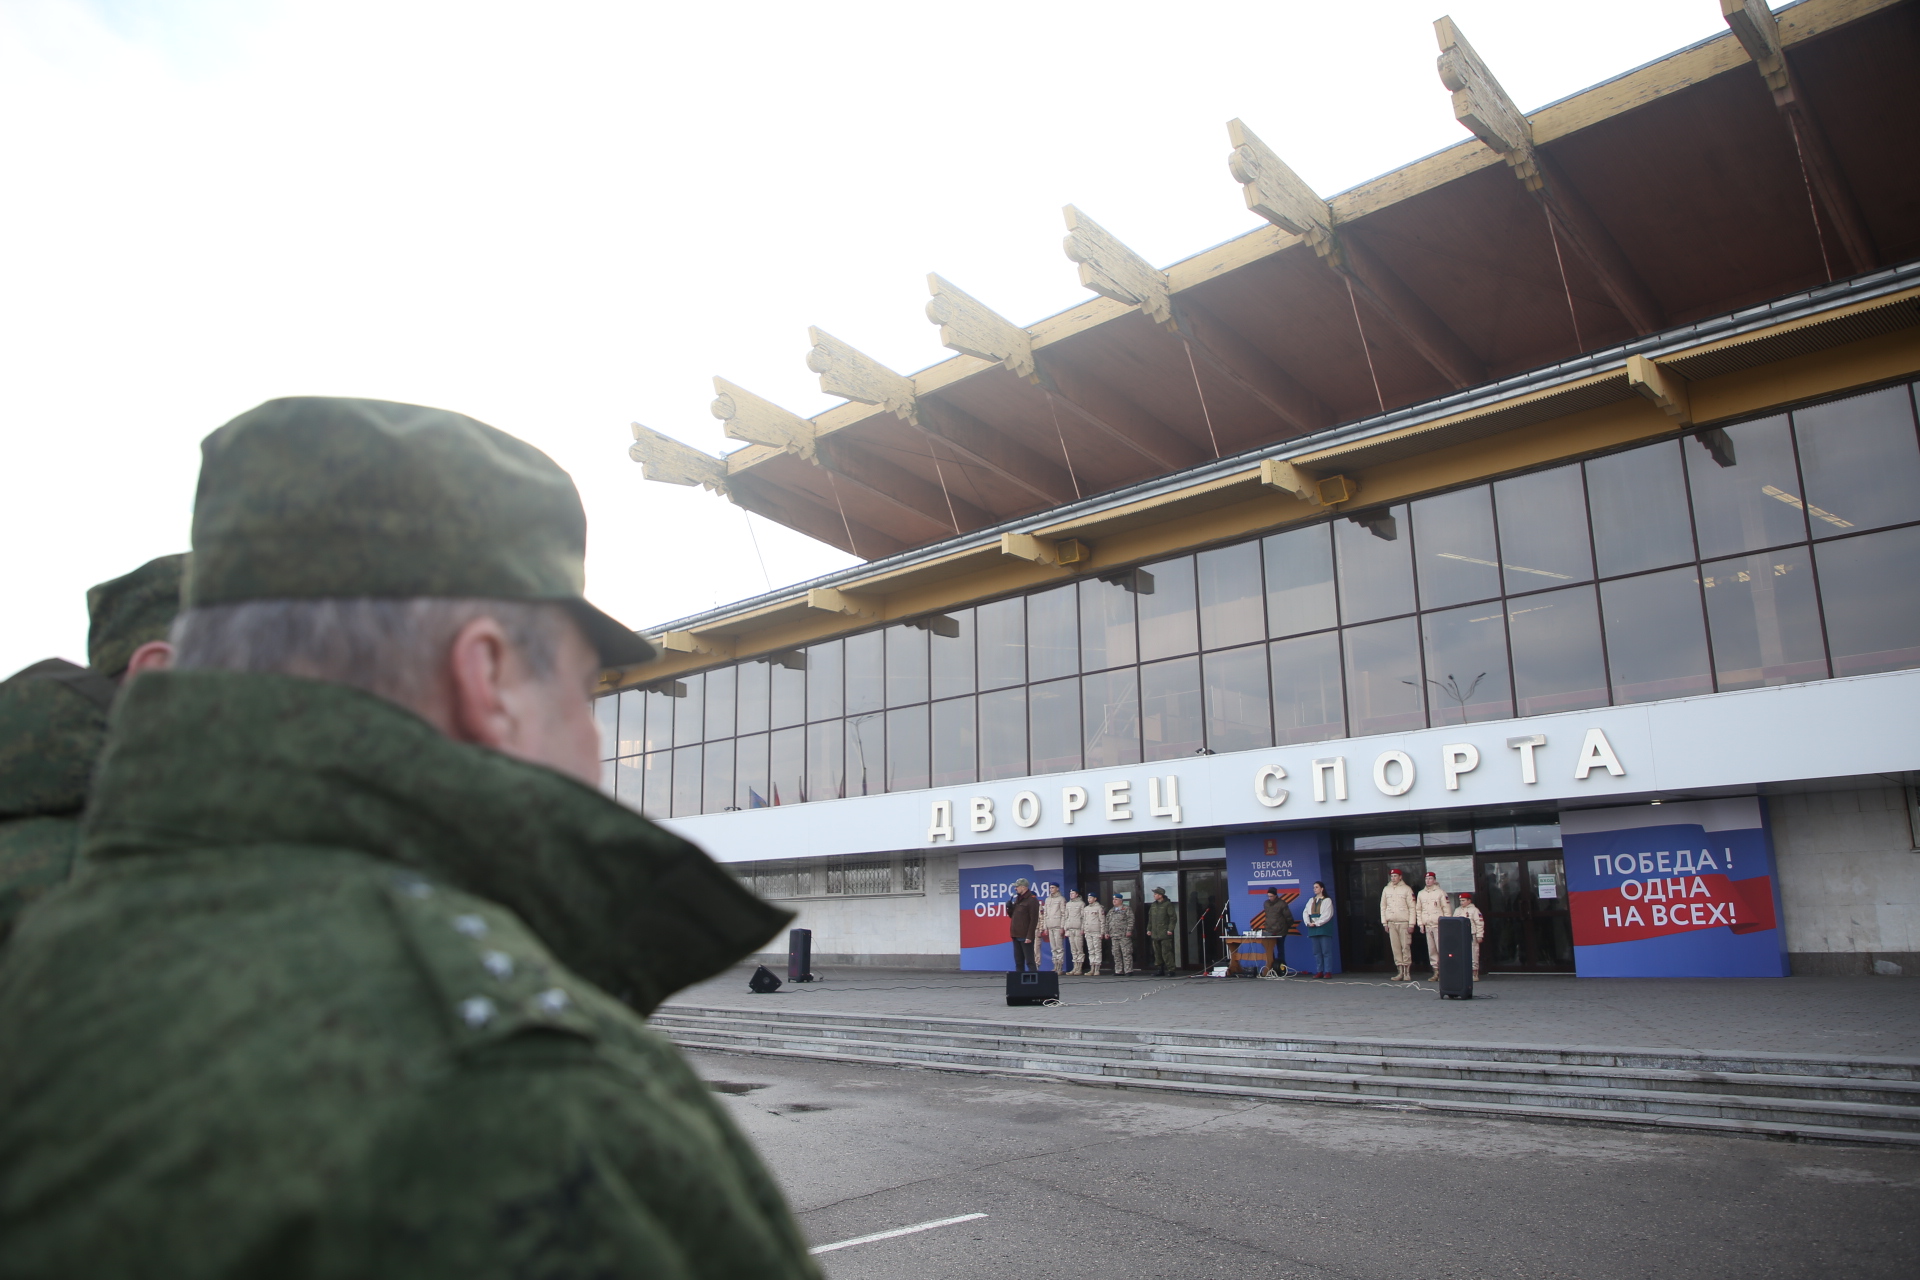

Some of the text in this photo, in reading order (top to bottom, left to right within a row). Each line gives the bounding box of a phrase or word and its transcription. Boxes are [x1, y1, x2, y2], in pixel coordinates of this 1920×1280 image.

[927, 728, 1626, 842] ДВОРЕЦ СПОРТА
[1251, 860, 1293, 870] ТВЕРСКАЯ
[1253, 869, 1292, 878] ОБЛАСТЬ
[1593, 848, 1719, 876] ПОБЕДА
[971, 881, 1050, 899] ТВЕРСАЯ
[1620, 876, 1712, 903] ОДНА
[1602, 902, 1737, 928] НА ВСЕХ!
